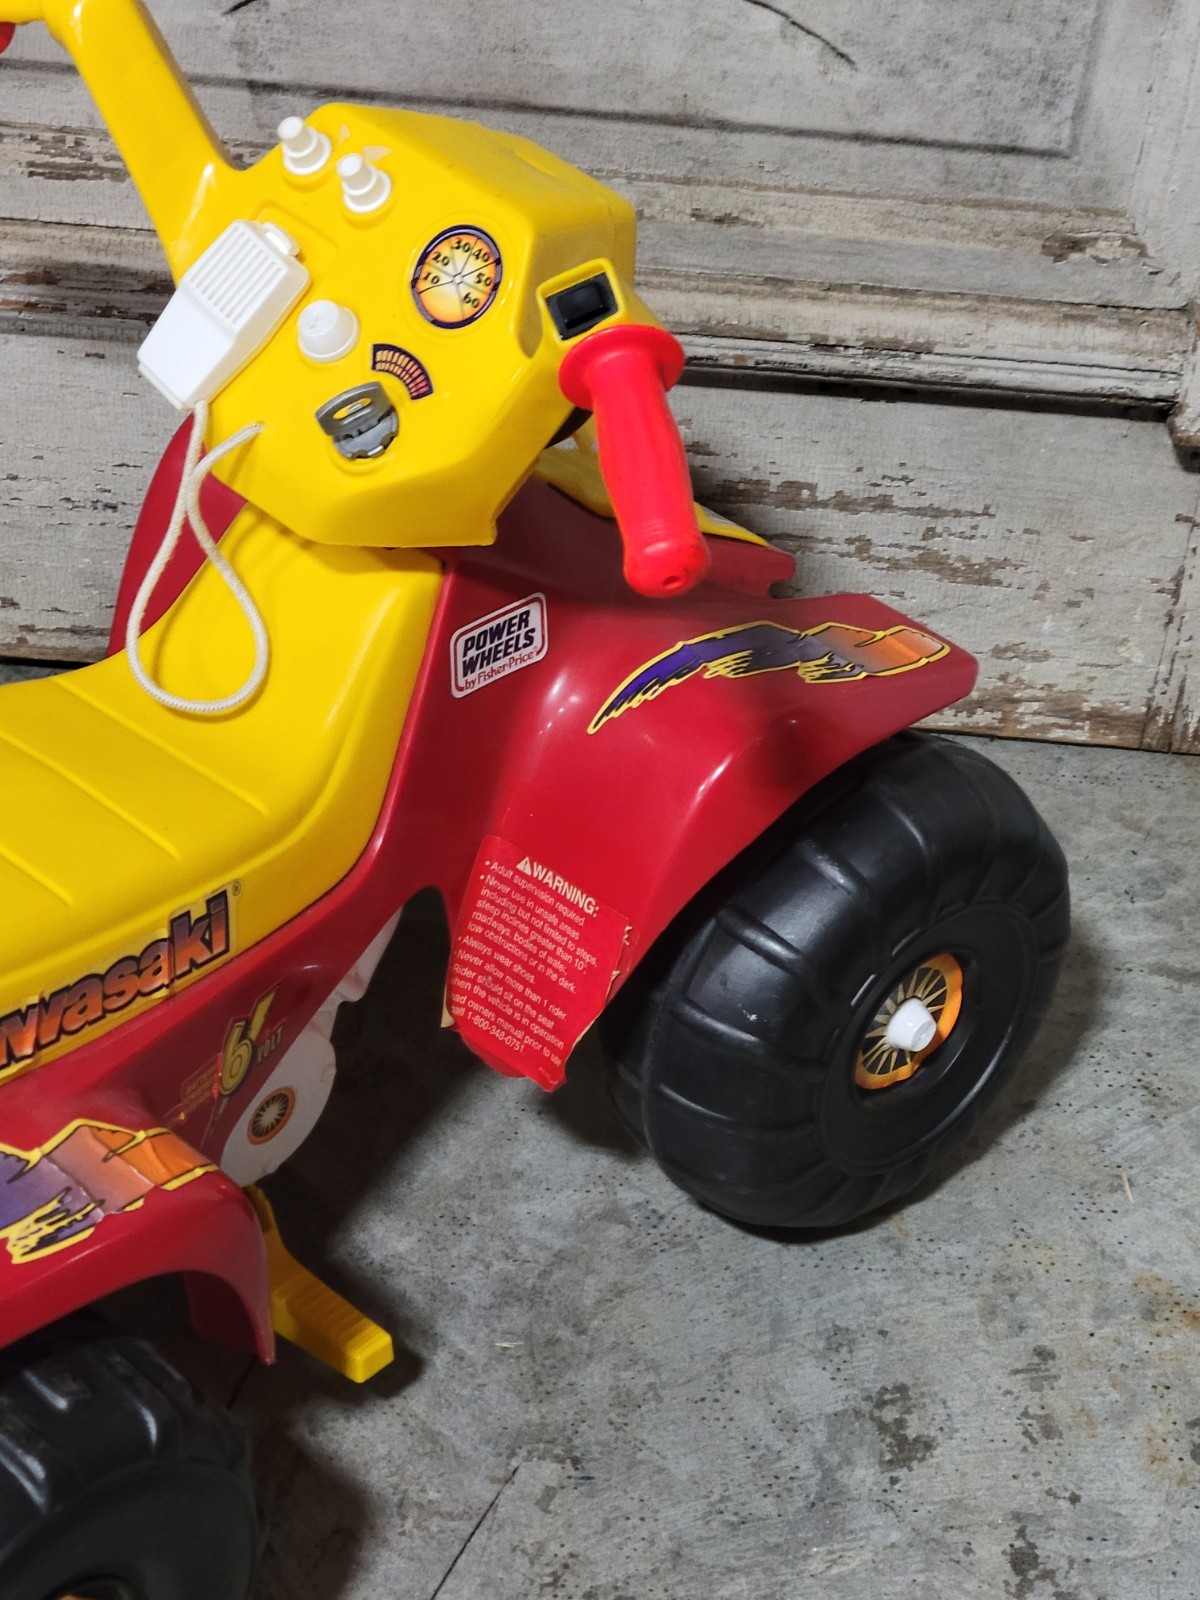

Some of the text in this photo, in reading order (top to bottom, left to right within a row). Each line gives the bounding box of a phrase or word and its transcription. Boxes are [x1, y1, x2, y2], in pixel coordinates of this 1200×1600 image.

[432, 251, 450, 266] 20
[452, 238, 471, 252] 30
[472, 248, 490, 262] 40
[422, 272, 440, 284] 10
[463, 292, 481, 309] 60
[475, 272, 492, 287] 50
[462, 609, 531, 659] POWER
[462, 627, 536, 678] WHEELS
[464, 678, 477, 691] by
[485, 875, 580, 940] Never use in unsafe areas
[491, 862, 585, 927] Adult supervision required
[533, 861, 600, 918] WARNING:
[476, 899, 500, 916] steep
[501, 910, 529, 934] inclines
[529, 930, 556, 952] greater
[555, 946, 573, 963] than
[480, 886, 517, 914] including
[517, 909, 531, 922] but
[531, 916, 544, 929] not
[543, 923, 568, 946] limited
[567, 940, 576, 951] to
[462, 936, 493, 956] Always
[493, 951, 514, 968] wear
[467, 921, 484, 934] low
[484, 929, 528, 961] obstructions
[528, 958, 539, 967] or
[537, 963, 546, 973] in
[545, 967, 558, 982] the
[513, 932, 538, 954] bodies
[538, 950, 548, 960] of
[452, 963, 555, 1030] Rider should sit on the seat
[457, 950, 484, 967] Never
[484, 962, 505, 979] allow
[504, 975, 524, 993] more
[524, 987, 541, 1004] than
[543, 999, 549, 1008] 1
[467, 999, 497, 1022] owners
[496, 1017, 525, 1040] manual
[523, 1035, 543, 1051] prior
[543, 1045, 551, 1058] to
[473, 984, 487, 998] the
[488, 994, 514, 1016] vehicle
[513, 1011, 521, 1021] is
[521, 1016, 530, 1026] in
[530, 1022, 565, 1050] operation
[220, 1018, 254, 1096] 6
[256, 1026, 284, 1064] VOLT
